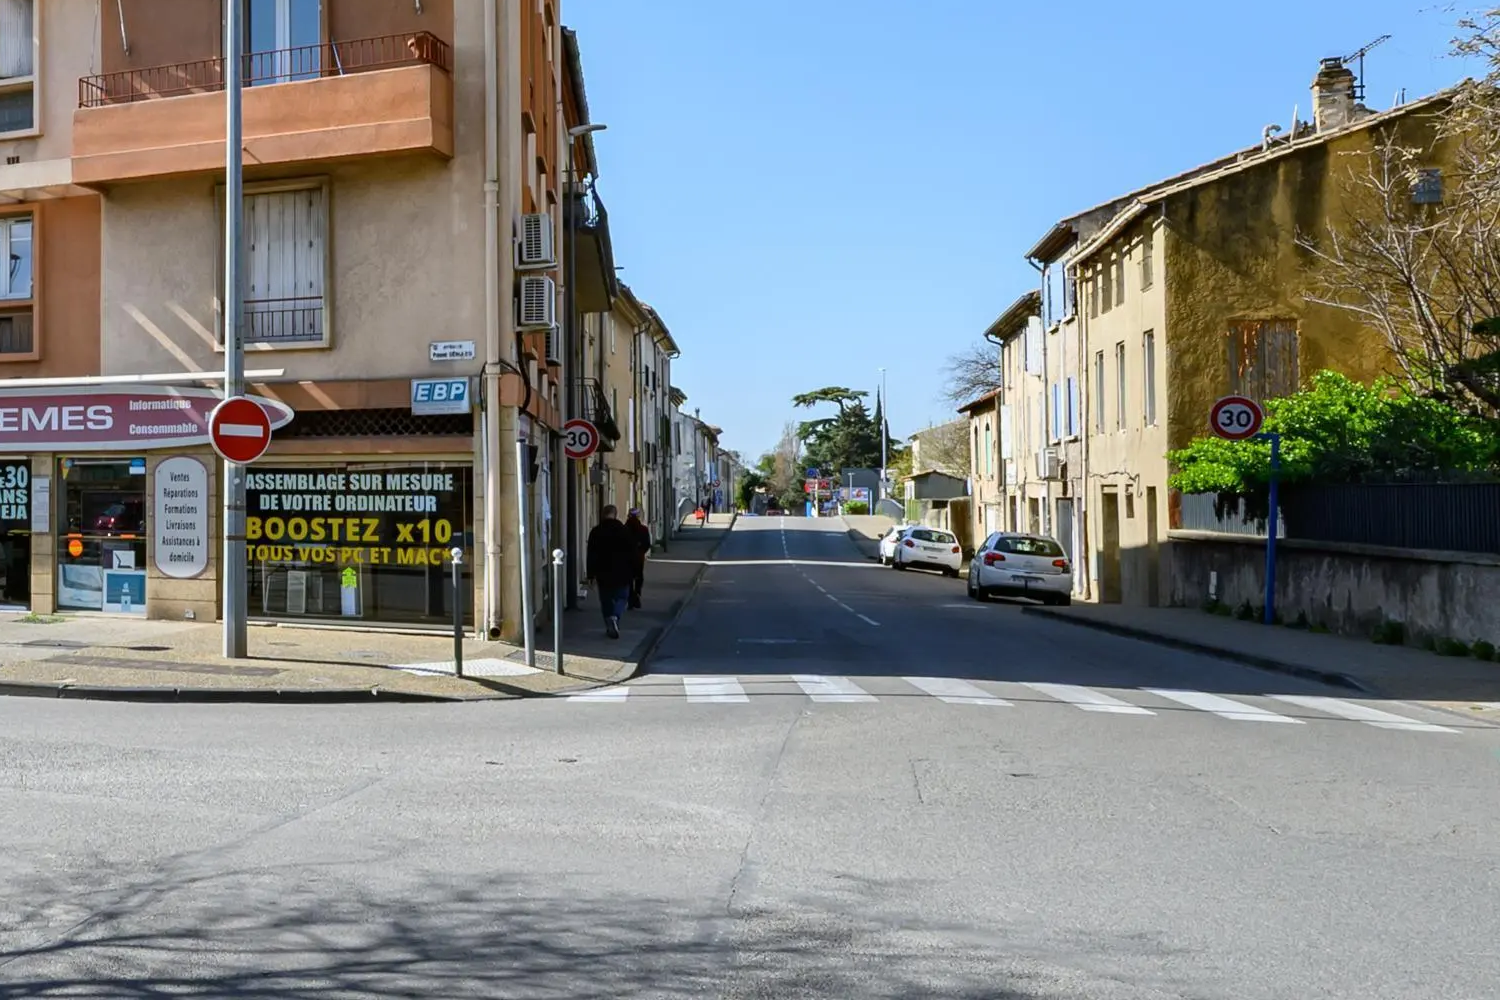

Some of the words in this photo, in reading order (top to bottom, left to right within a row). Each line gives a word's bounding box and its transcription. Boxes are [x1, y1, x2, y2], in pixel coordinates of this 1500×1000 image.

[417, 383, 465, 401] EBP
[129, 399, 192, 411] Informatique
[1221, 409, 1252, 428] 30
[129, 422, 198, 435] Consommable
[567, 431, 590, 447] 30
[5, 465, 29, 489] 30
[169, 472, 190, 482] Ventes
[246, 473, 346, 491] ASSEMBLAGE
[349, 473, 382, 491] SUR
[385, 473, 454, 491] MESURE
[163, 487, 198, 500] Réparations
[164, 503, 197, 514] Formations
[259, 494, 279, 511] DE
[281, 494, 332, 511] VOTRE
[334, 494, 437, 512] ORDINATEUR
[165, 519, 196, 530] Livraisons
[245, 516, 380, 542] BOOSTEZ
[395, 518, 452, 544] x10
[162, 535, 195, 546] Assistances
[169, 551, 194, 562] domicile
[246, 545, 294, 562] TOUS
[296, 546, 337, 563] VOS
[340, 547, 365, 564] PC
[369, 547, 392, 564] ET
